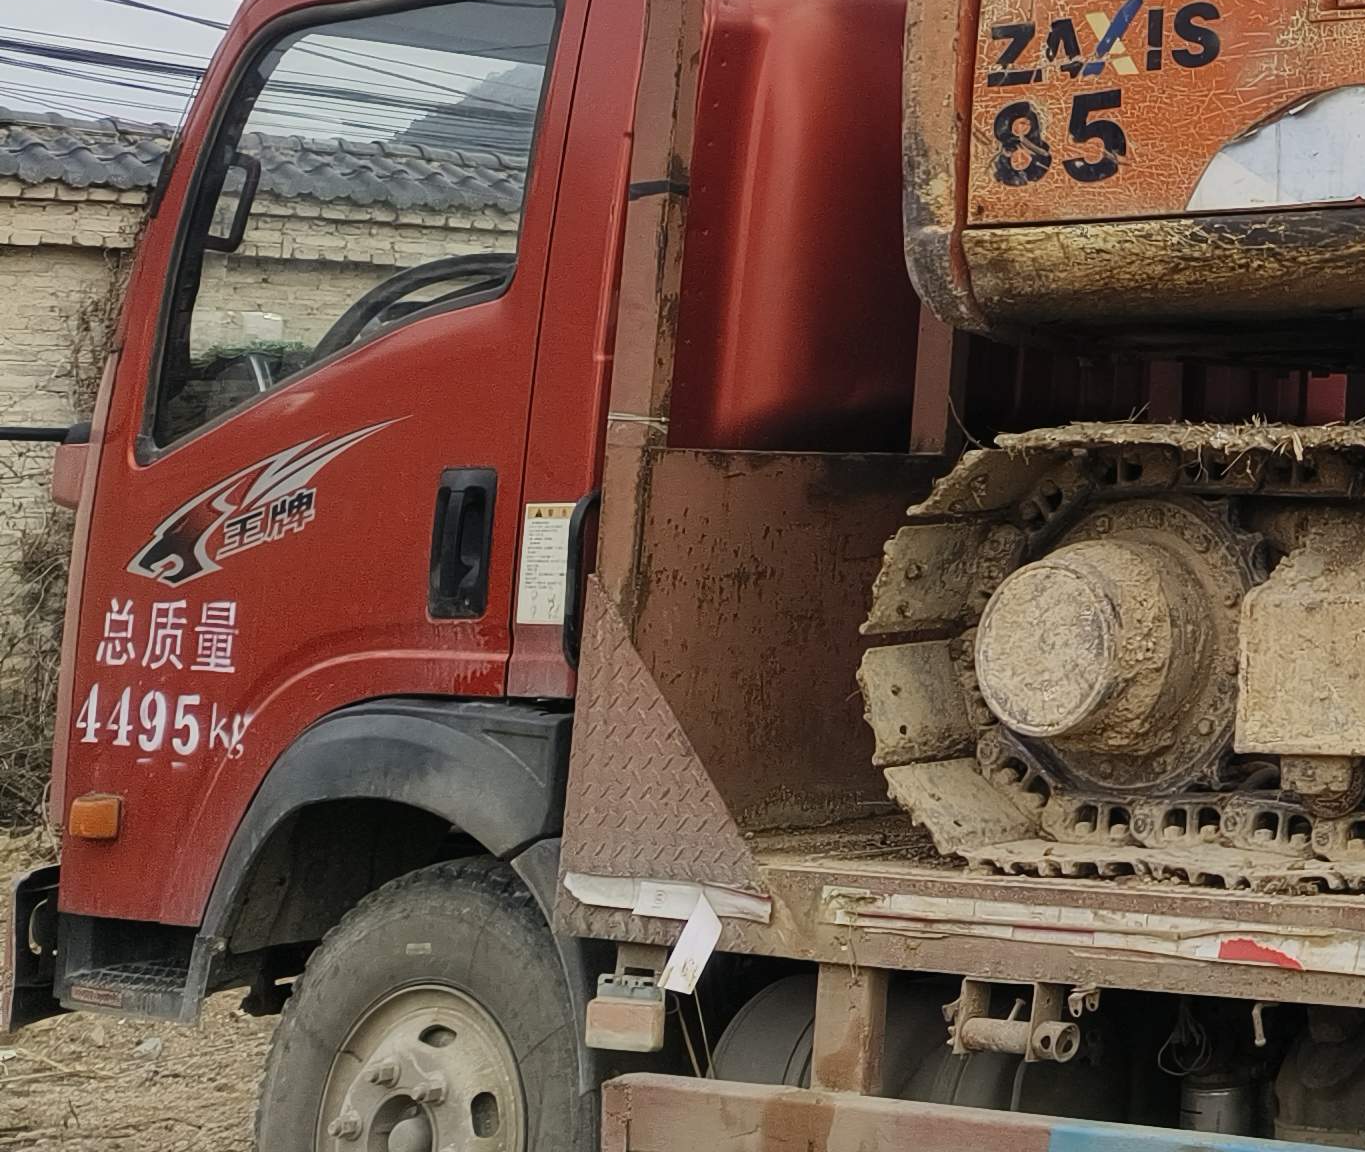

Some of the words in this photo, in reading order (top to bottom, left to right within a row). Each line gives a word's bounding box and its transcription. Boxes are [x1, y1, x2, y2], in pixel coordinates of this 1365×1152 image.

[993, 89, 1127, 187] 85
[217, 488, 317, 560] 王牌
[96, 598, 239, 673] 总质量
